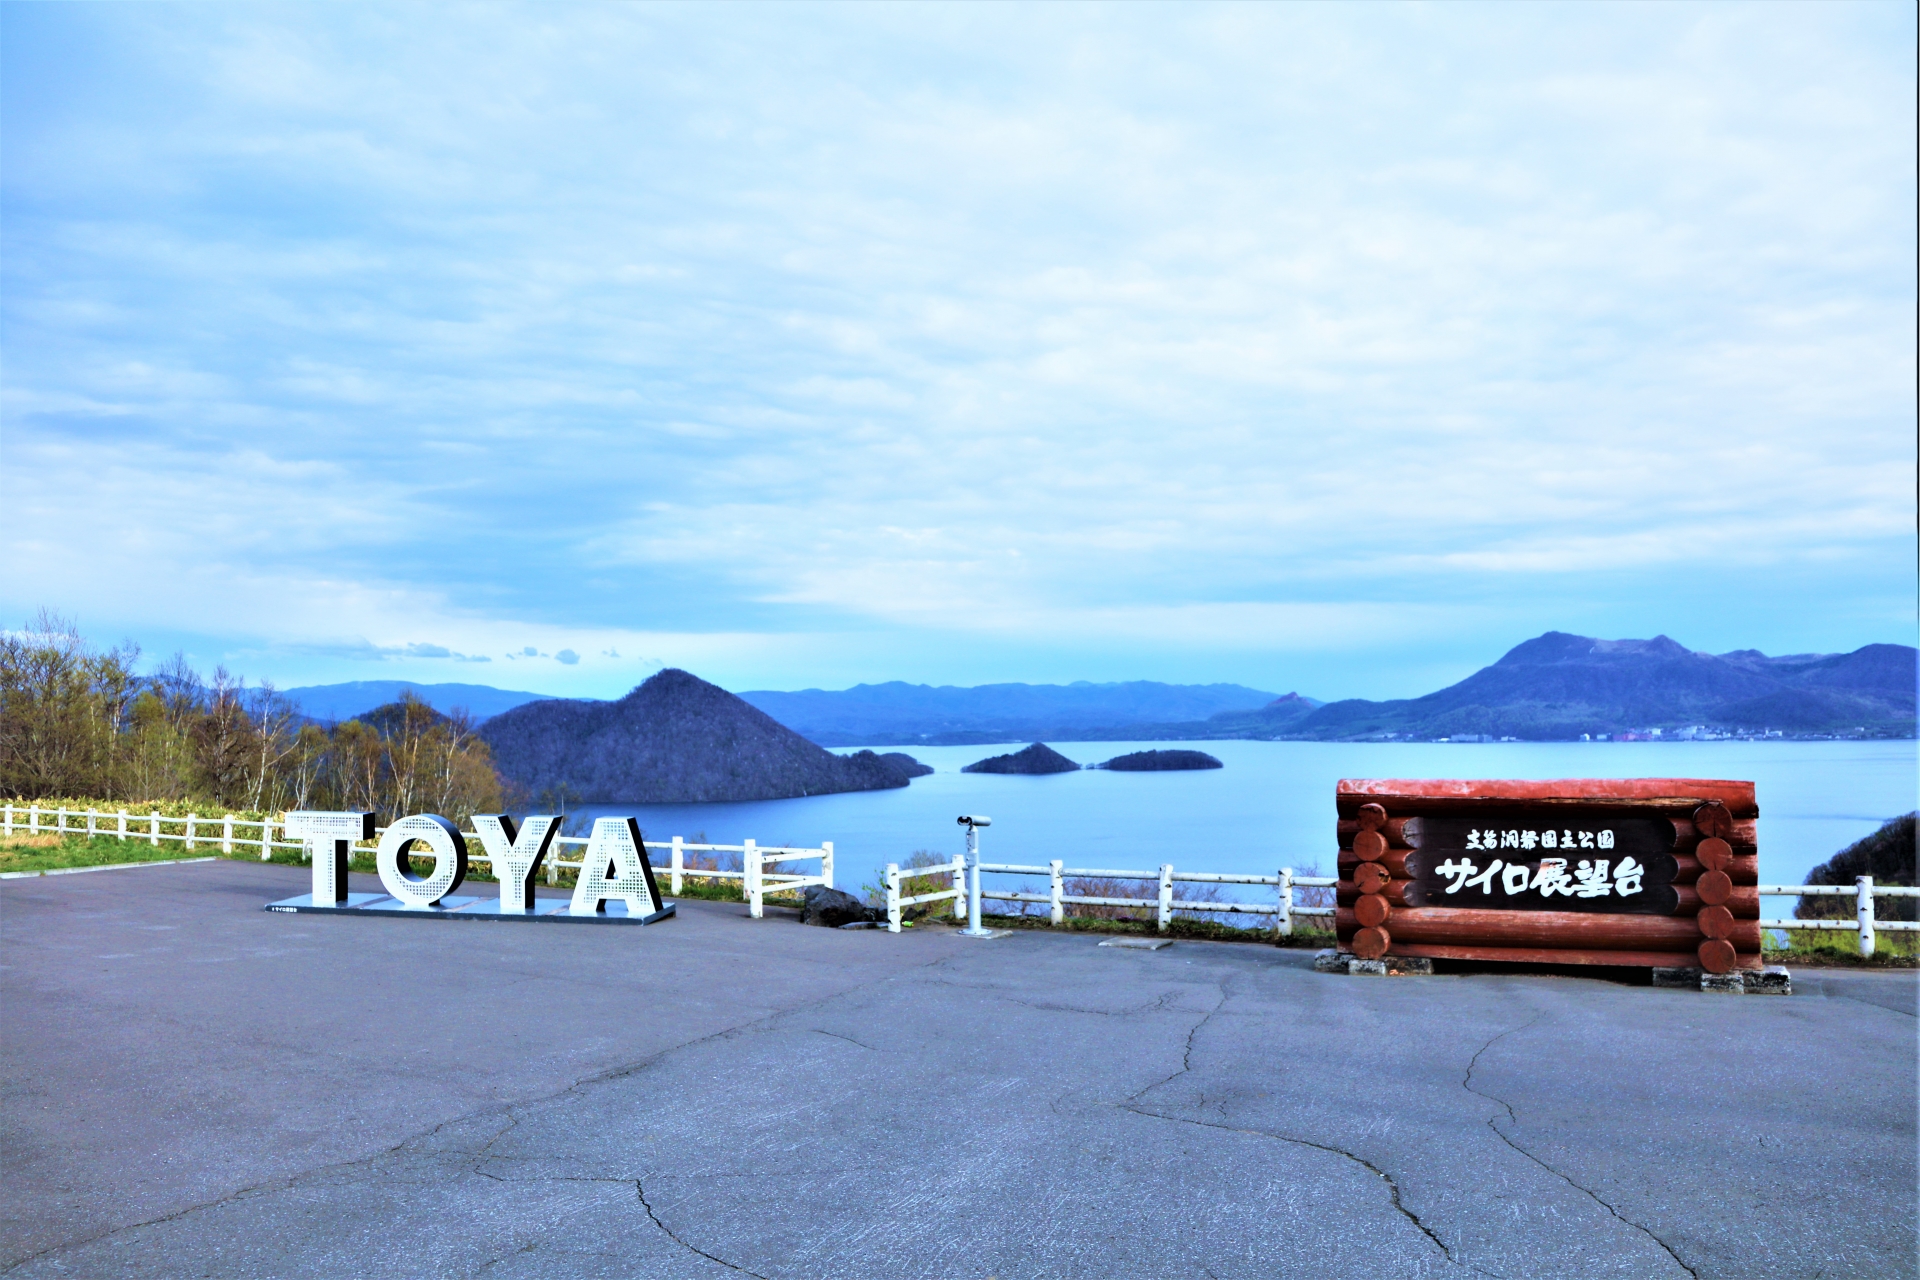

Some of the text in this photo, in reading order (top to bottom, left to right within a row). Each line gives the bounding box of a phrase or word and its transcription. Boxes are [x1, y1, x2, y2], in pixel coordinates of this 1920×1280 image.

[285, 811, 663, 912] TOYA
[1435, 856, 1644, 898] サイロ展望台
